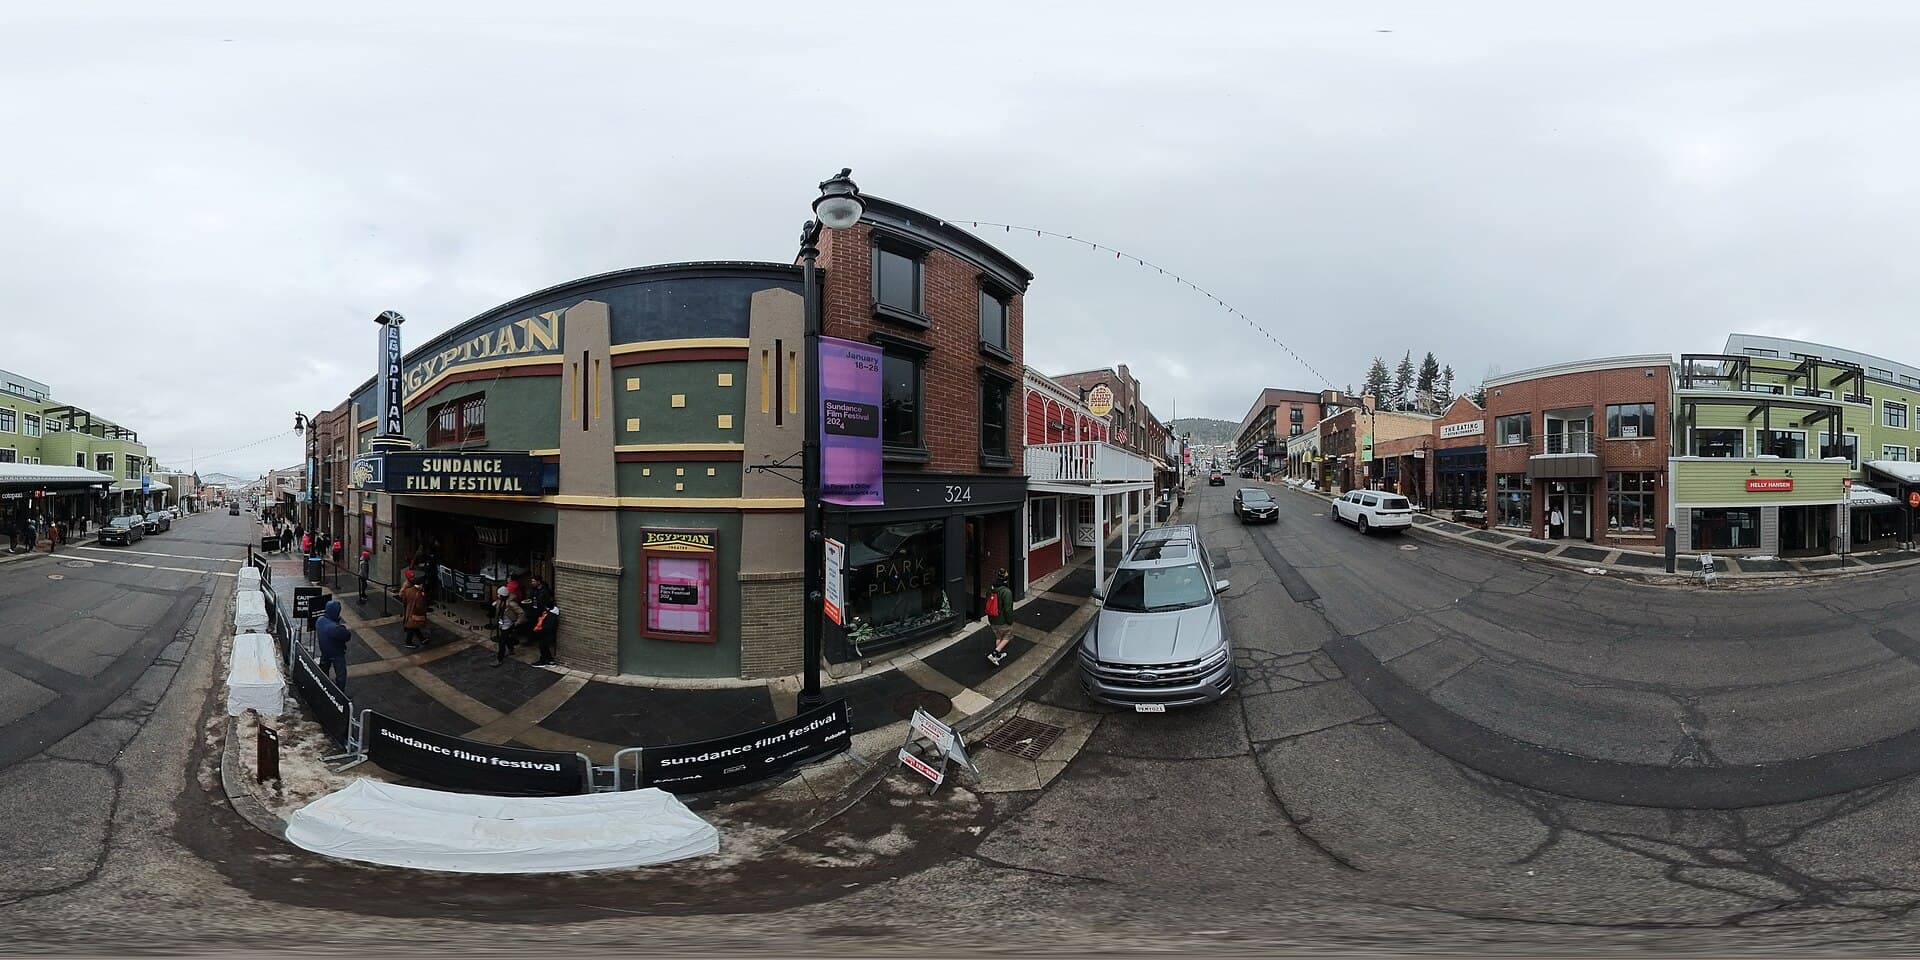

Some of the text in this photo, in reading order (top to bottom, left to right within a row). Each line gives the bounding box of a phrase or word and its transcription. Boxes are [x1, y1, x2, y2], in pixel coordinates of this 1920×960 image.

[846, 351, 879, 365] January
[388, 327, 401, 433] EGYPTIAN
[826, 402, 862, 413] Sundance
[826, 409, 870, 421] Film Festival
[826, 417, 845, 430] 2024
[1456, 423, 1479, 431] EATING
[422, 459, 502, 473] SUNDANCE
[406, 475, 522, 491] FILM FESTIVAL
[944, 485, 972, 503] 324
[647, 533, 709, 545] EGYPTIAN
[876, 557, 925, 579] PARK
[868, 571, 931, 598] PLACE
[660, 744, 752, 767] sundance
[754, 734, 786, 749] film
[788, 712, 836, 738] festival
[380, 728, 561, 772] sundance film festival
